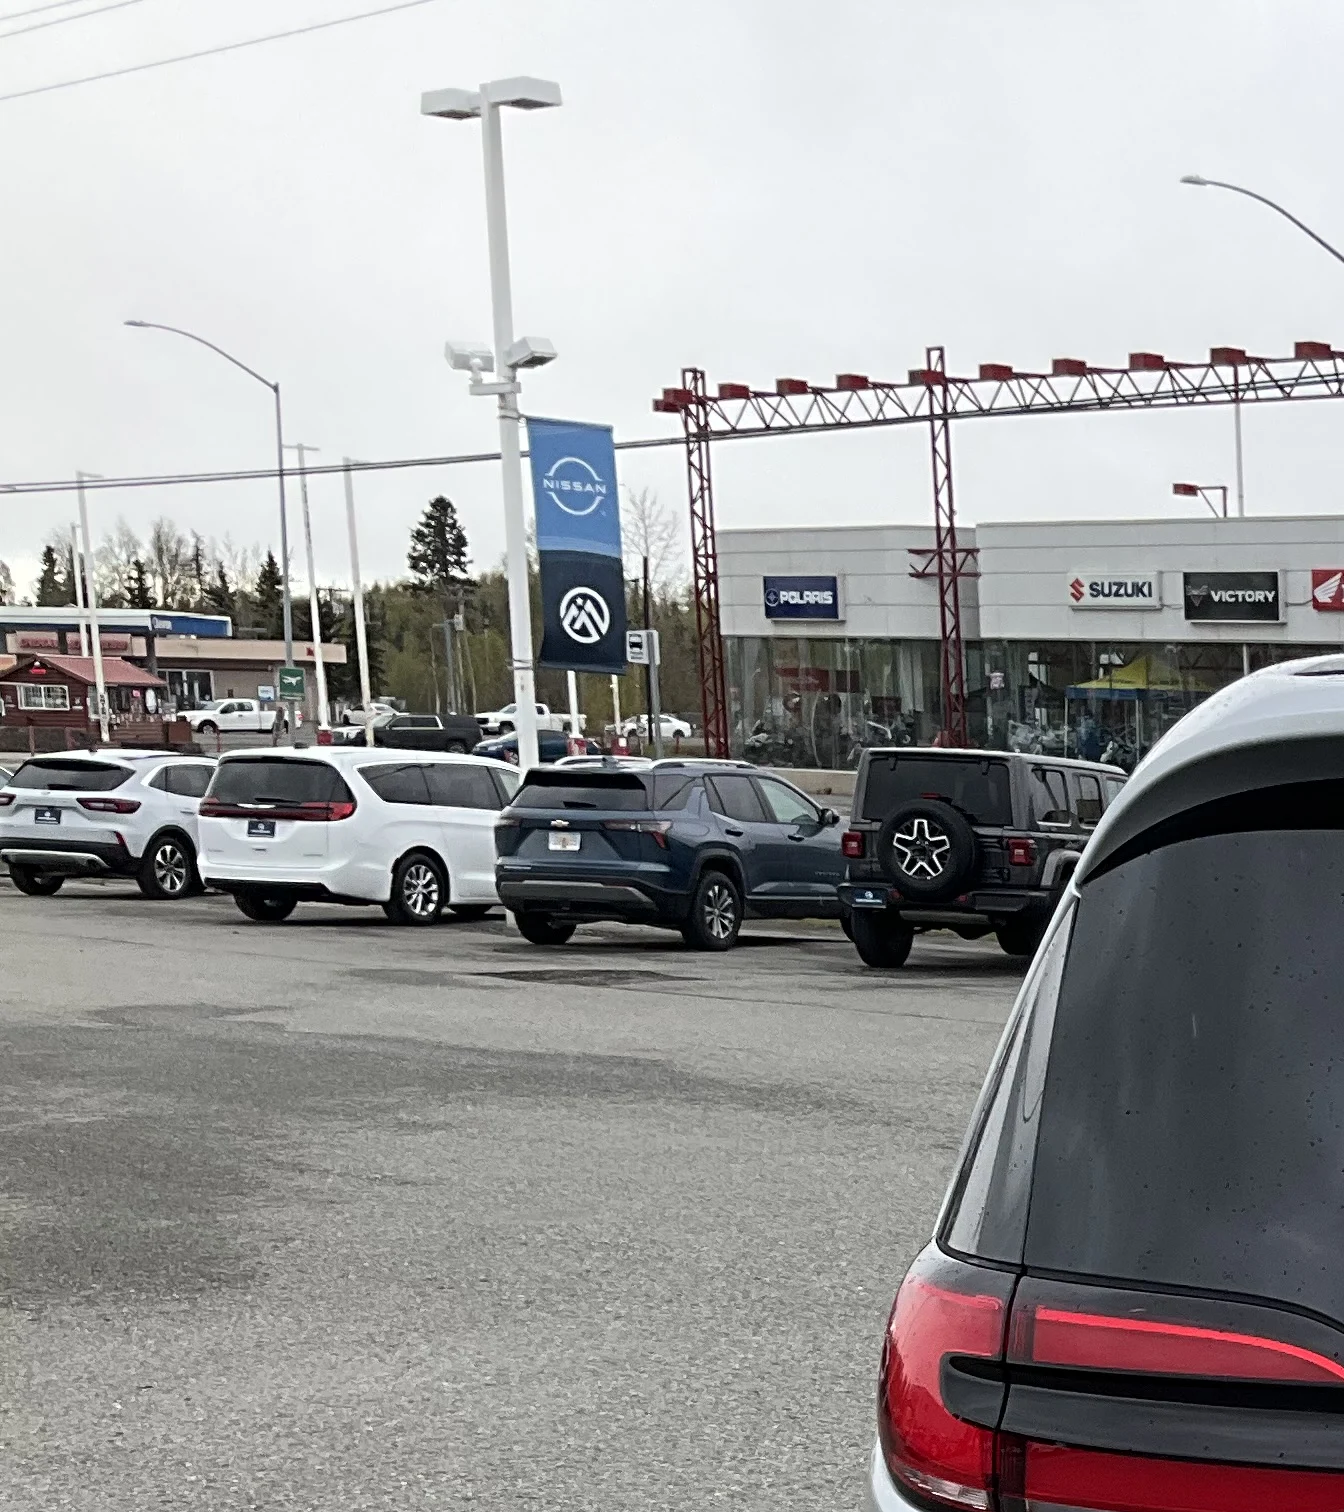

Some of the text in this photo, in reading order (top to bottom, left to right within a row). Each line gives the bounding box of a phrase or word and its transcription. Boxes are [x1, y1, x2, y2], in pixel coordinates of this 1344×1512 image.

[543, 478, 607, 494] NISSAN
[780, 590, 834, 604] POLARIS
[1089, 581, 1153, 599] SUZUKI
[1210, 590, 1276, 603] VICTORY
